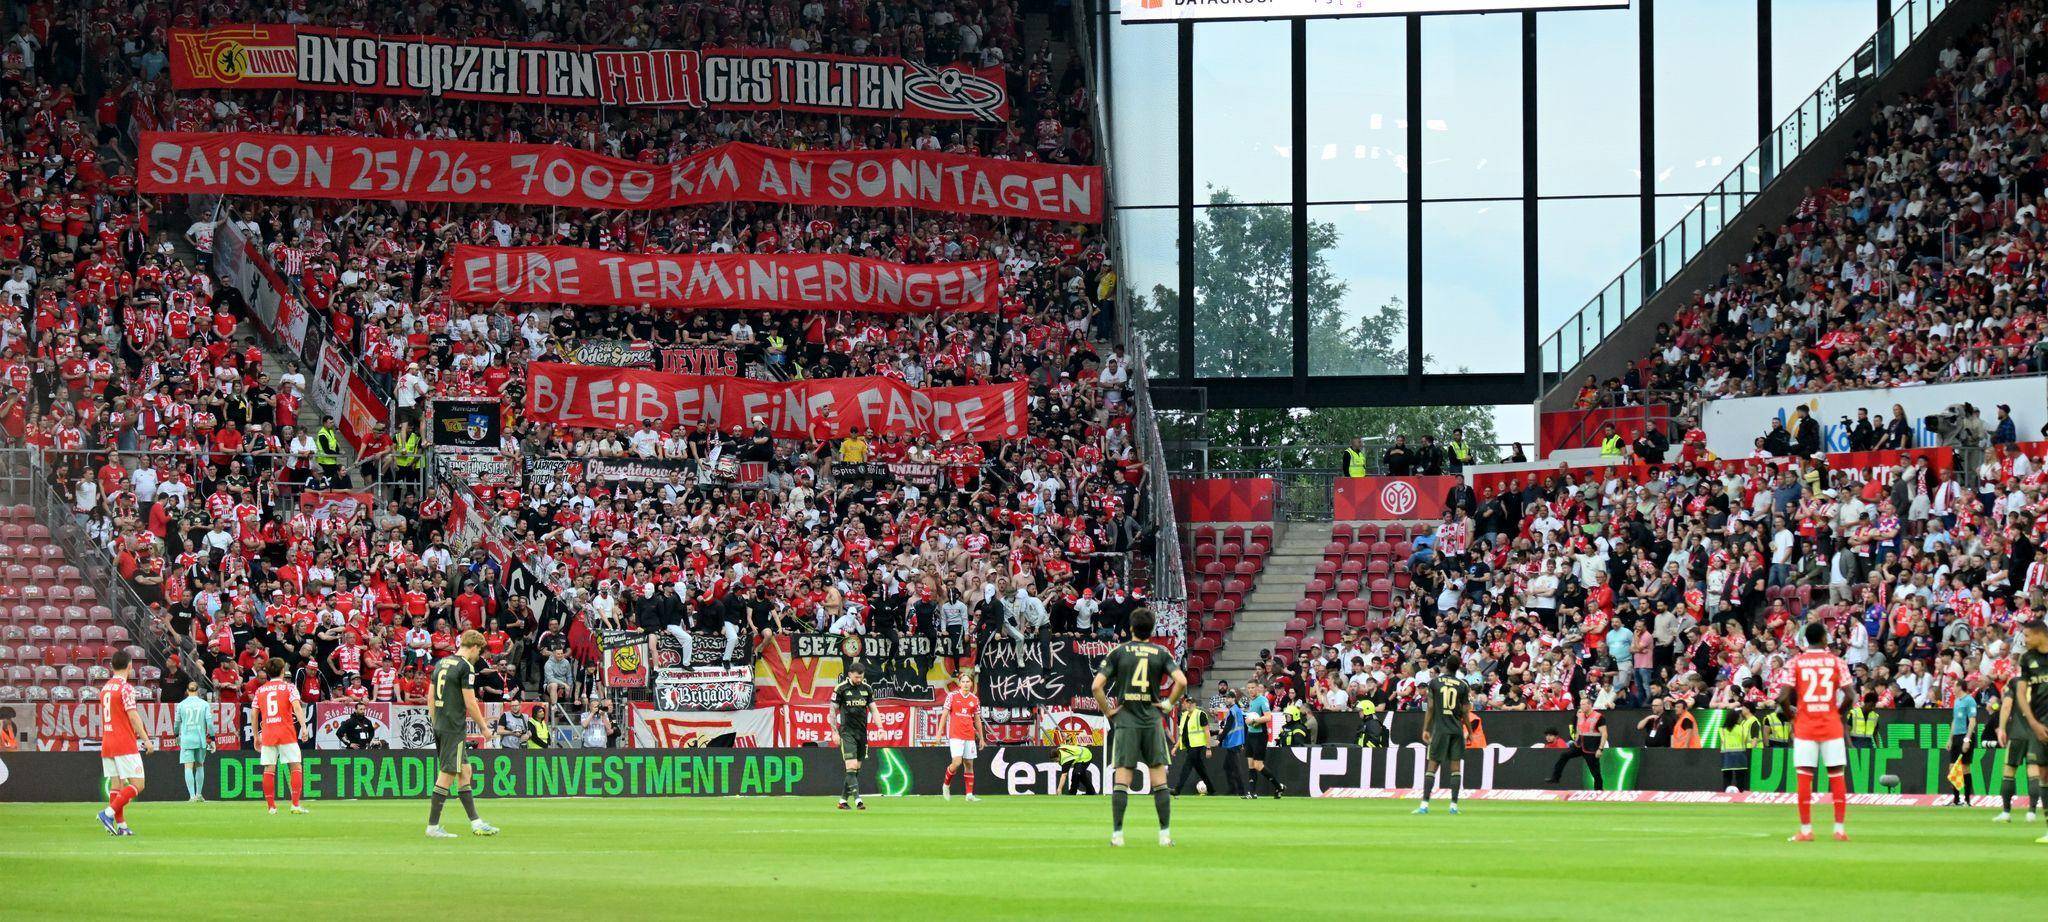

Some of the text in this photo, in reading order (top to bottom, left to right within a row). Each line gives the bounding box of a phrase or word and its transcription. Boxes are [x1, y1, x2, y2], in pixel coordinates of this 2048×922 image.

[247, 49, 296, 74] UNION
[595, 49, 706, 108] FAIR
[705, 57, 904, 111] GESTALTEN
[350, 147, 491, 195] 25/26:
[511, 153, 654, 201] 7000
[670, 153, 740, 200] KM
[758, 158, 813, 198] AN
[827, 159, 1091, 215] SONNTAGEN
[464, 253, 580, 295] EURE
[661, 350, 738, 376] DEVILS
[857, 388, 986, 441] FARCE
[586, 458, 695, 482] Oberschönewide
[798, 636, 844, 656] SEZ.
[437, 669, 448, 700] 6
[1131, 657, 1149, 692] 4
[1801, 667, 1834, 702] 23
[103, 692, 111, 722] 8
[266, 691, 279, 717] 6
[679, 686, 732, 704] Brigade
[1440, 685, 1457, 710] 10
[41, 702, 237, 737] SACHNAER
[185, 708, 201, 725] 27
[794, 711, 822, 724] Von
[796, 728, 818, 741] bis
[220, 757, 321, 798] DENE
[492, 756, 516, 796] &
[525, 756, 734, 796] INVESTMENT
[740, 756, 803, 794] APP
